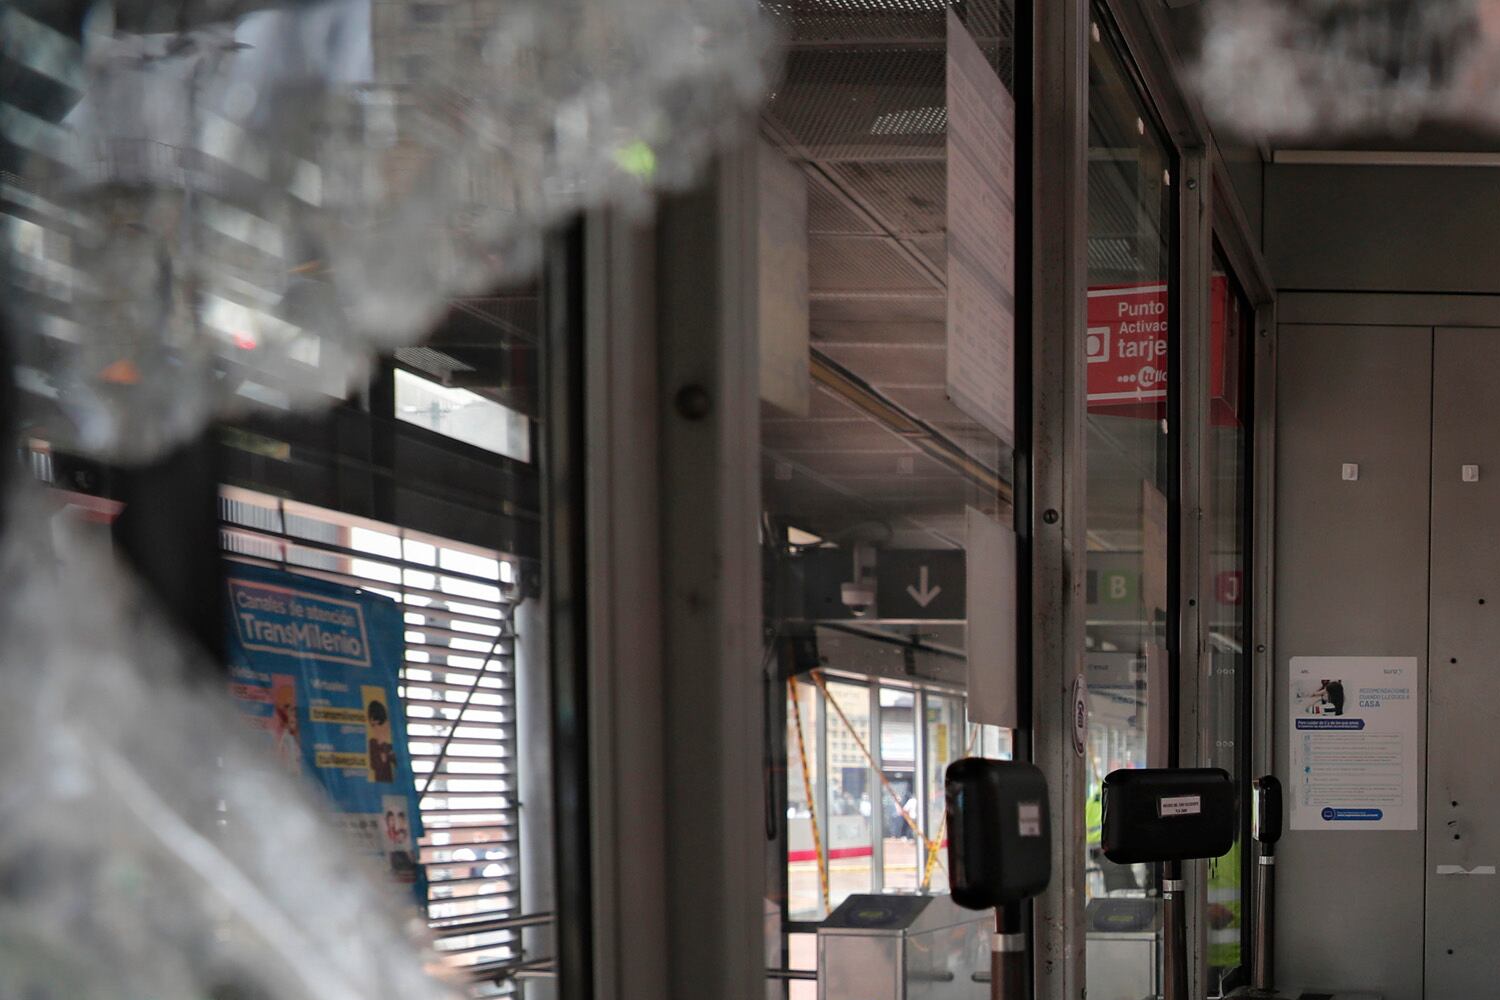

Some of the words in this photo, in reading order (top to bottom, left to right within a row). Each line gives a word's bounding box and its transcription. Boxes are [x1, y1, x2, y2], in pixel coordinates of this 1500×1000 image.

[1118, 301, 1165, 317] Punto
[1119, 320, 1167, 334] Activac
[1117, 336, 1167, 362] tarje
[1109, 575, 1127, 599] B
[1225, 577, 1239, 601] J
[236, 591, 286, 614] Canales
[240, 613, 361, 656] TransMilenio
[1359, 700, 1381, 708] CASA
